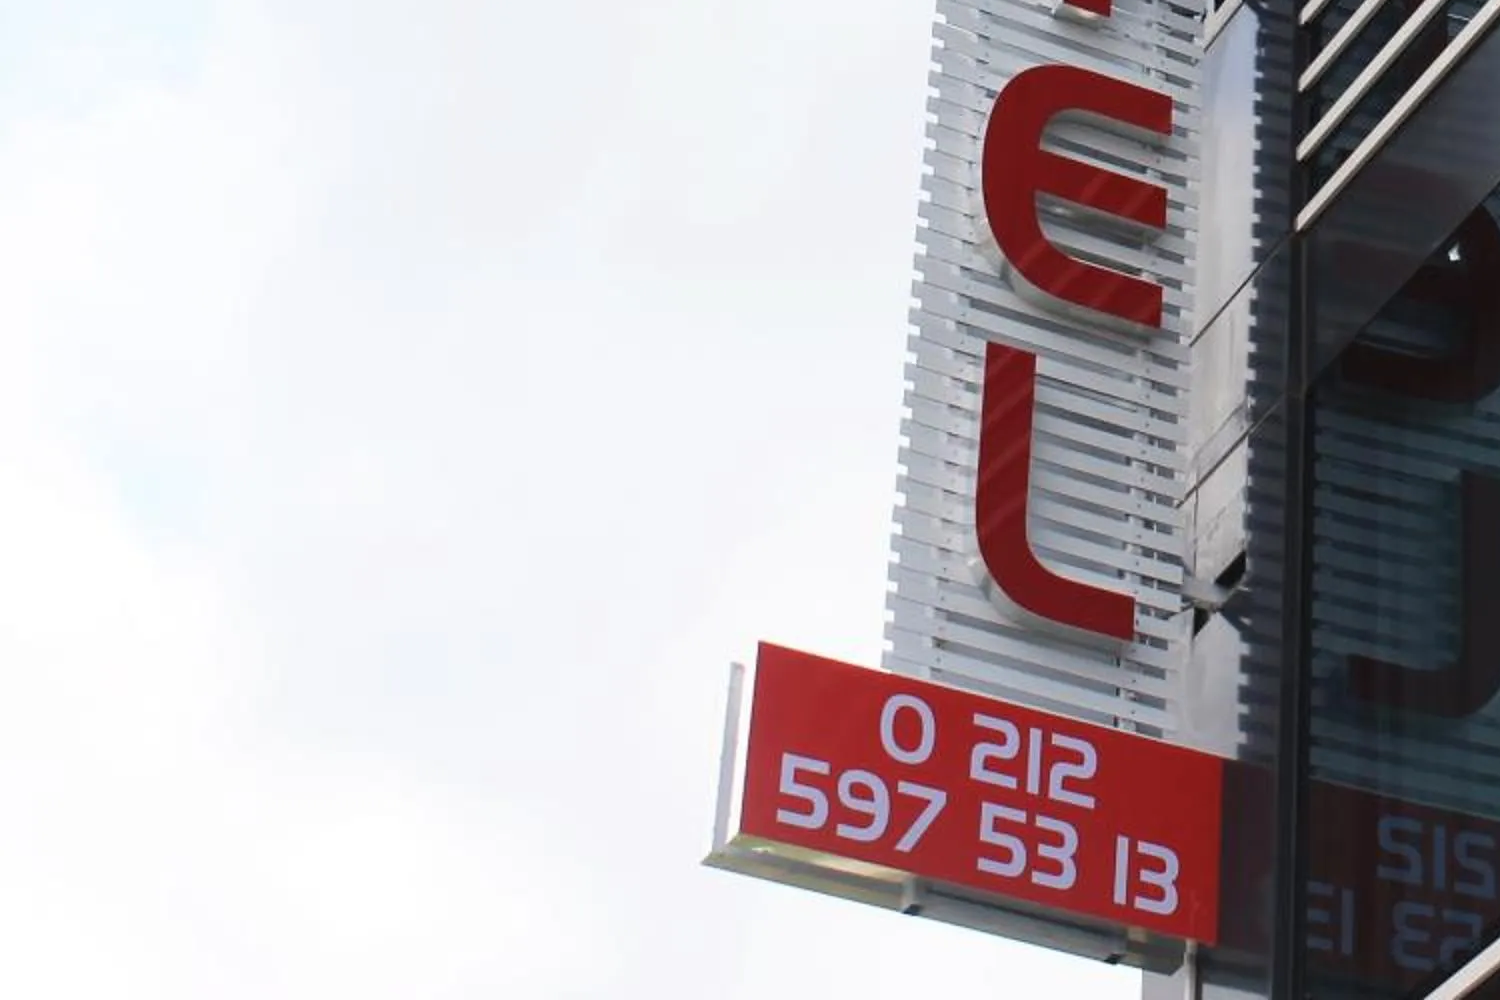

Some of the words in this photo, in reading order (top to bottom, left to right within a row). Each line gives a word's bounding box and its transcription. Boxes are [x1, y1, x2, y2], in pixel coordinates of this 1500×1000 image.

[969, 712, 1098, 809] 212
[776, 752, 947, 853] 597
[976, 801, 1079, 891] 53
[1112, 835, 1180, 916] 13
